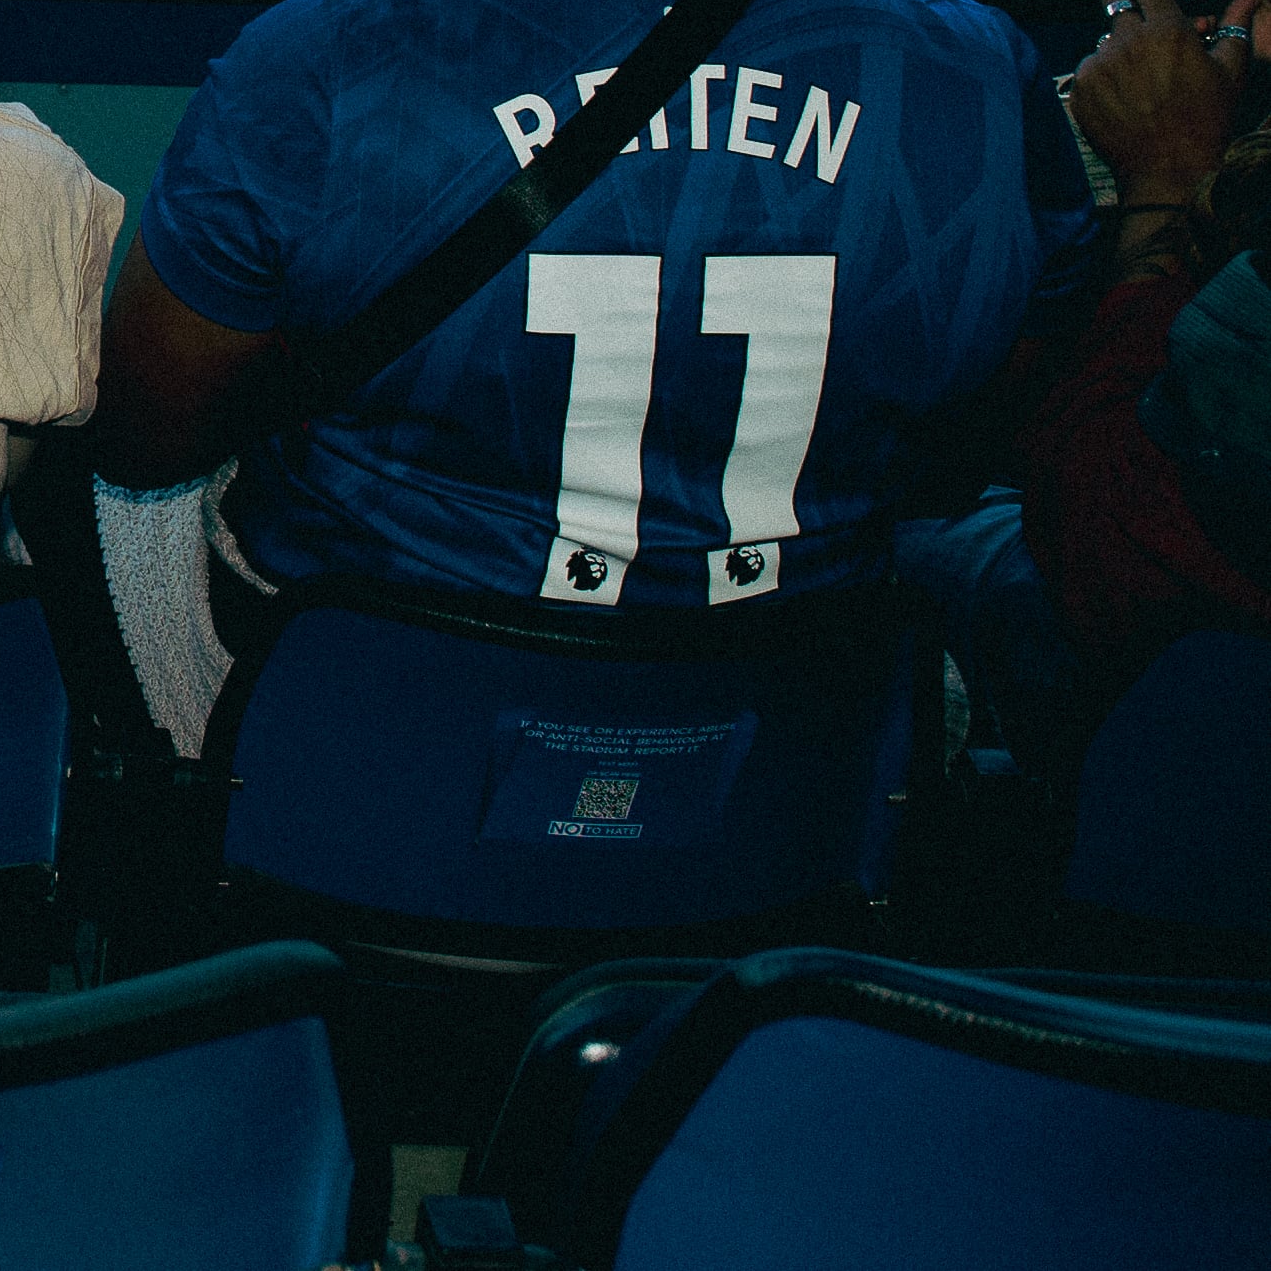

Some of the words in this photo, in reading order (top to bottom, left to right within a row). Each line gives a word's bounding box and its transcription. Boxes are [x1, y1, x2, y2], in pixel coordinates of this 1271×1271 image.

[492, 64, 862, 185] RTEN
[525, 253, 837, 606] 11
[537, 721, 564, 731] YOU
[568, 724, 590, 733] SEE
[594, 727, 613, 735] OR
[616, 727, 694, 736] EXPERIENCE
[525, 730, 543, 738] OR
[636, 734, 708, 746] BEHAVIOUR
[710, 733, 726, 741] AT
[545, 741, 568, 751] THE
[634, 746, 684, 755] REPORT
[551, 821, 582, 836] NO
[585, 825, 600, 835] TO
[604, 826, 638, 836] HATE
